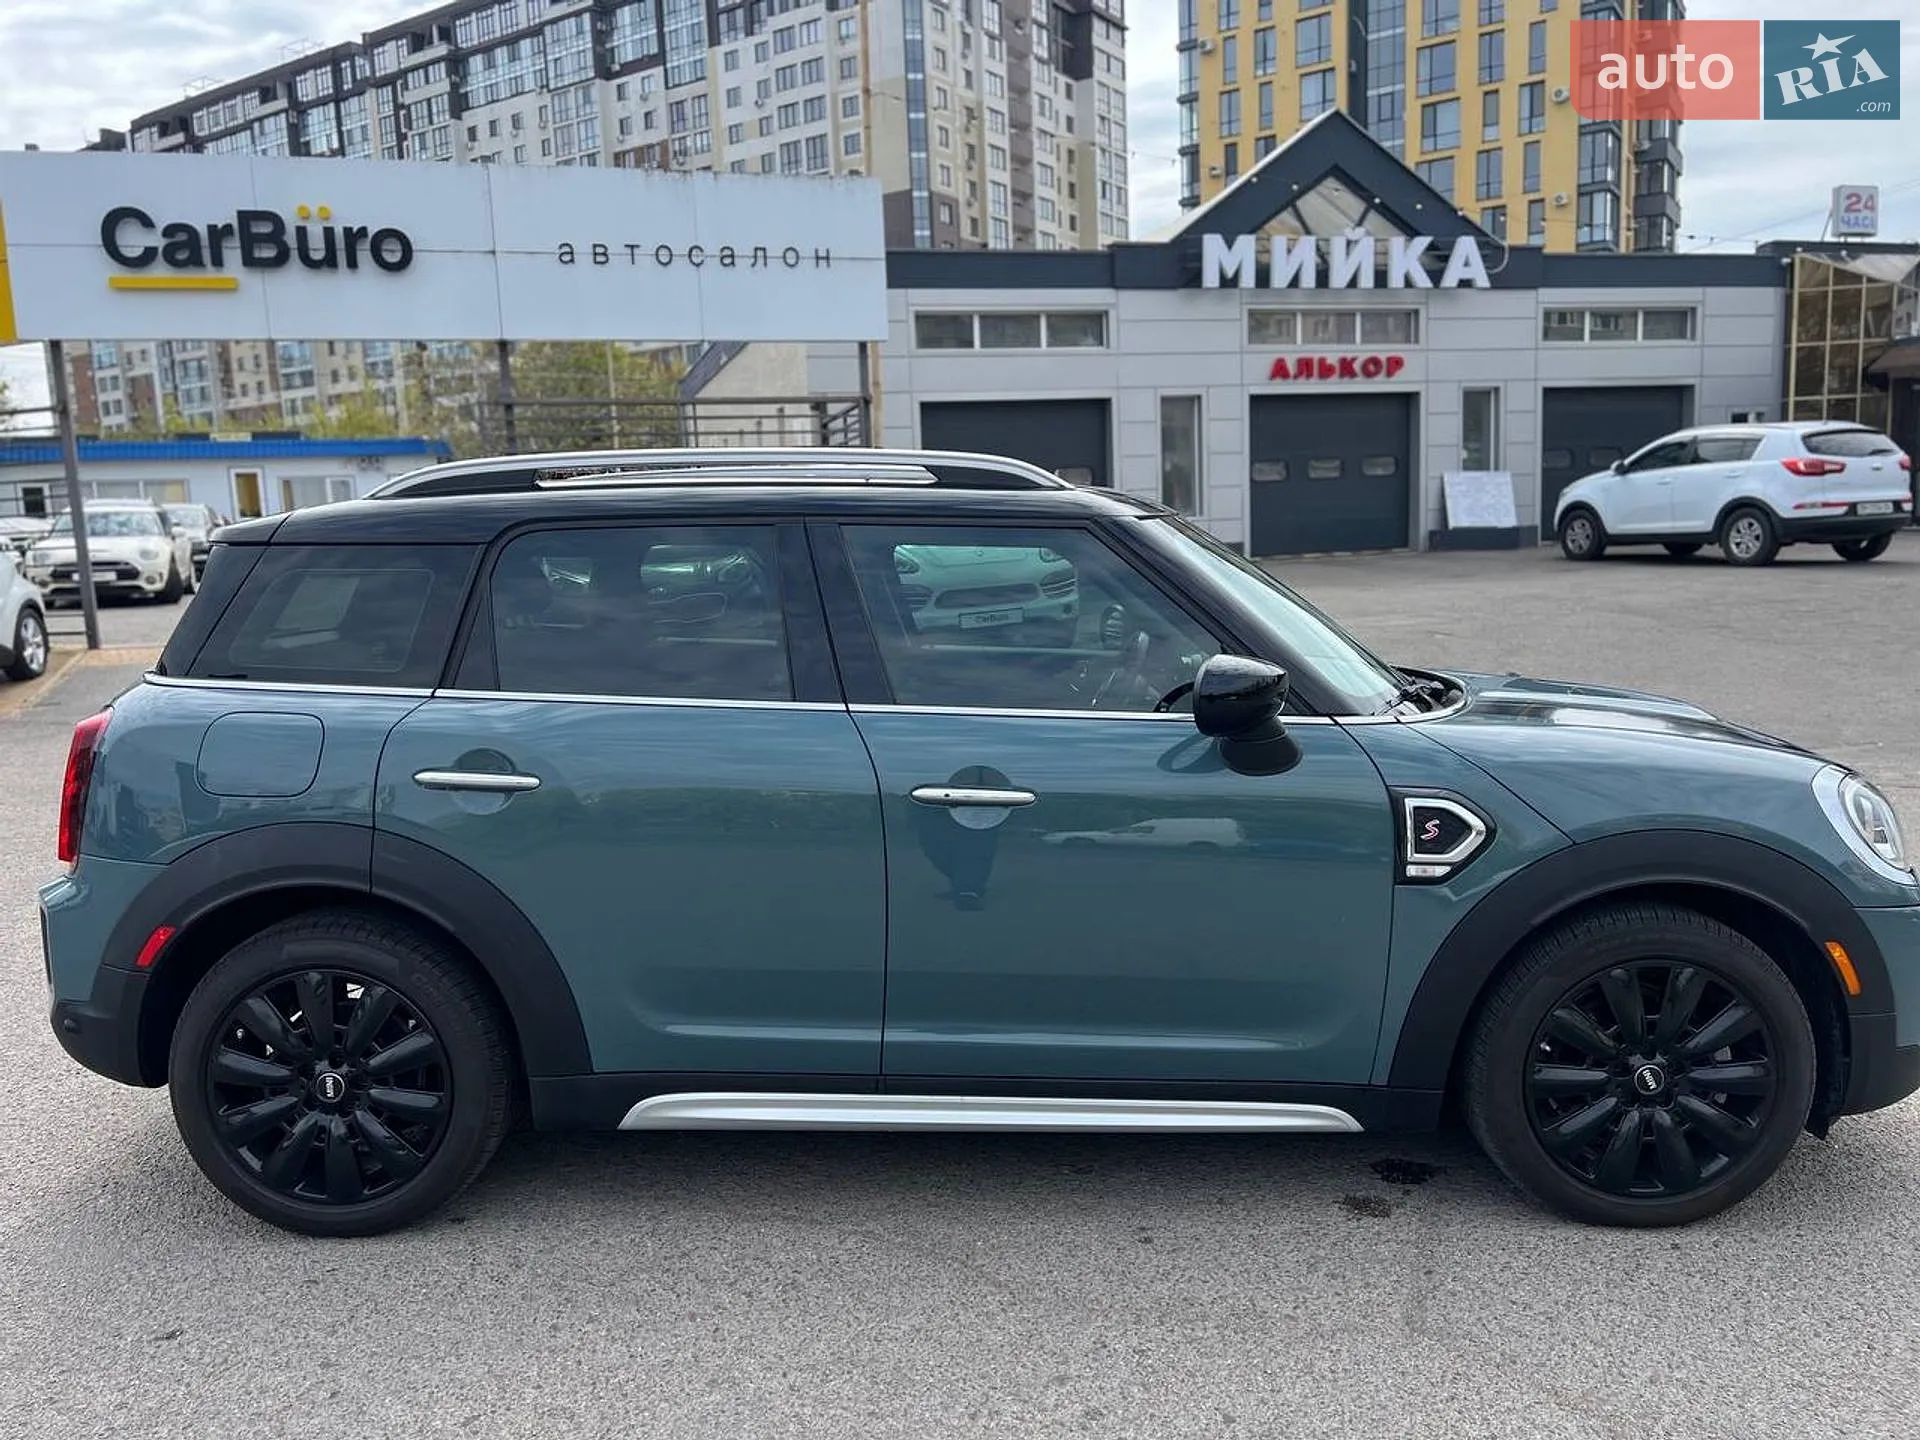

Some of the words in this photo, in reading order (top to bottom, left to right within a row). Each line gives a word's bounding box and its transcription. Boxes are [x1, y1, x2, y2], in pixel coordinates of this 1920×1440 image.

[1843, 192, 1875, 214] 24
[100, 204, 413, 273] CarBüro
[558, 242, 831, 268] автосалон
[1202, 226, 1492, 289] МИЙКА
[1269, 355, 1405, 381] АЛЬКОР
[1420, 819, 1440, 840] S
